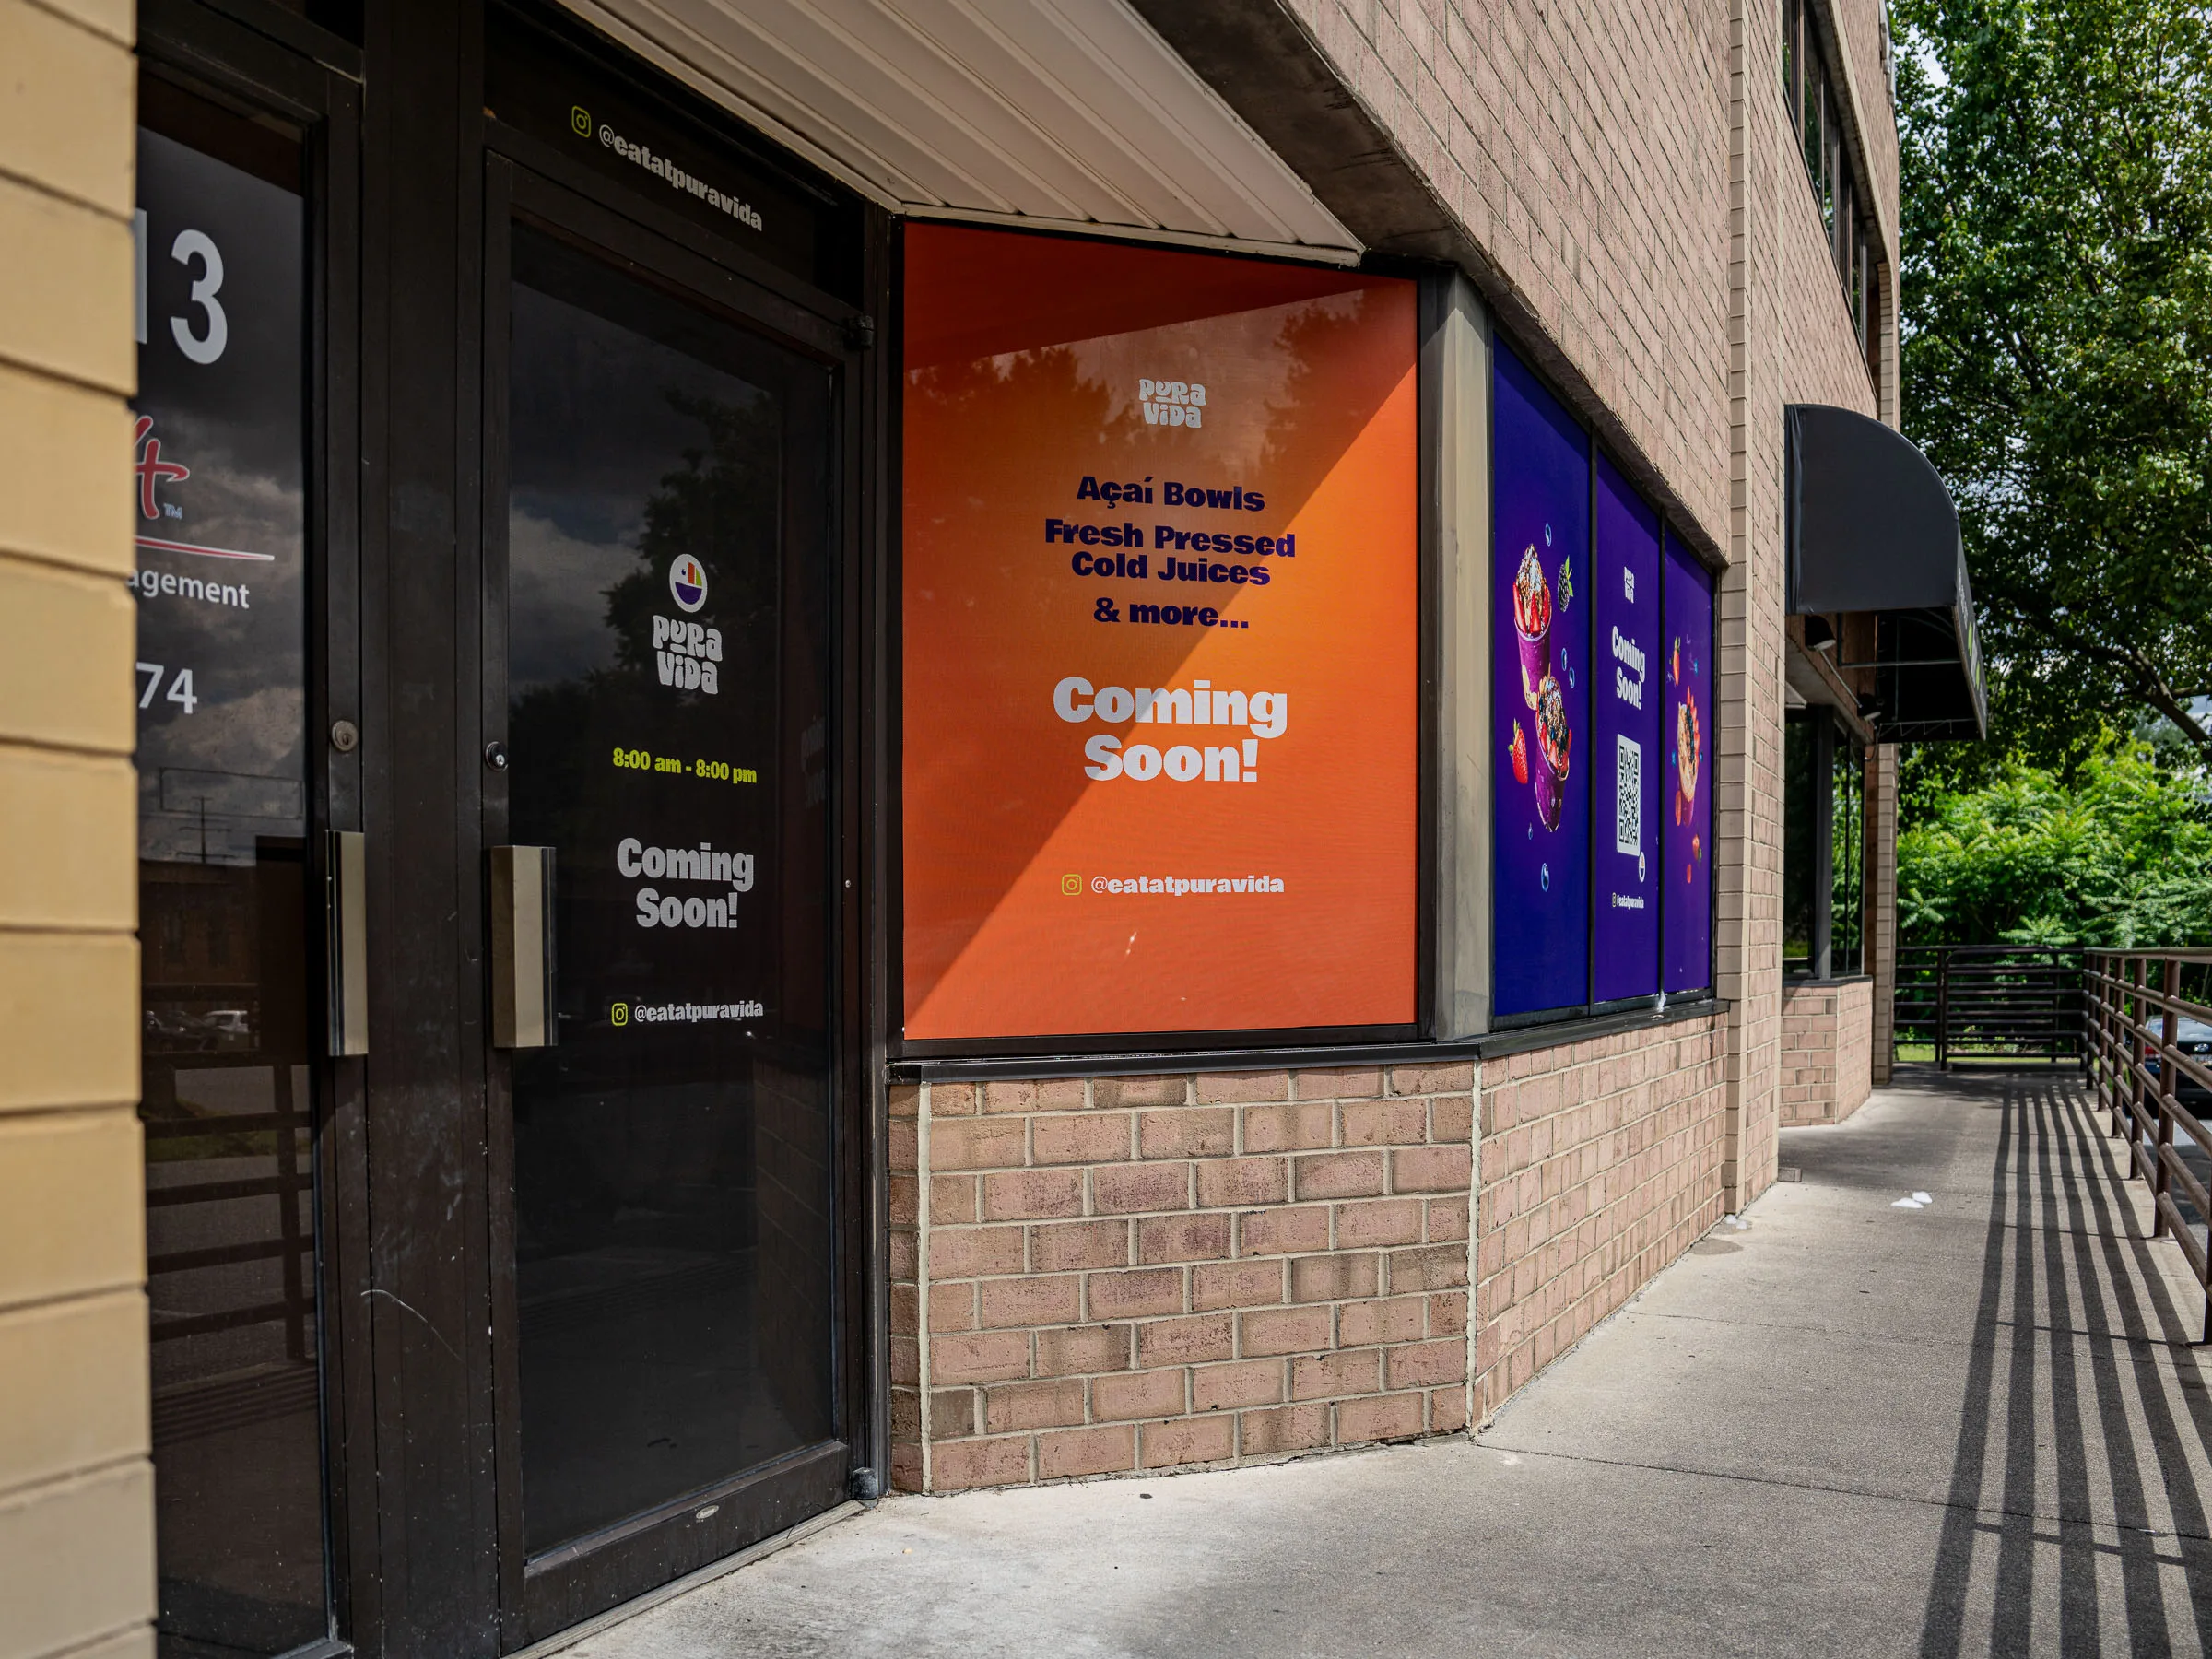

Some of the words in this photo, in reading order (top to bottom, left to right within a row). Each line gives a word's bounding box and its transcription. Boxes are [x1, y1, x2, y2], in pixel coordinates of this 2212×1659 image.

[599, 124, 762, 231] @eatatpuravida
[1077, 476, 1153, 509] Açaí
[1164, 482, 1265, 512] Bowls
[1045, 518, 1144, 547] Fresh
[1155, 525, 1296, 558] Pressed
[1072, 551, 1147, 579] Cold
[1158, 557, 1271, 585] Juices
[1094, 597, 1121, 623] &
[1612, 626, 1645, 683] Coming
[1053, 677, 1287, 739] Coming
[1617, 666, 1641, 710] Soon!
[613, 747, 651, 771] 8:00
[654, 757, 681, 774] am
[696, 759, 729, 781] 8:00
[733, 768, 757, 784] pm
[1084, 735, 1258, 782] Soon!
[617, 838, 754, 892] Coming
[1091, 876, 1285, 896] @eatatpuravida
[636, 888, 738, 929] Soon!
[634, 1000, 763, 1023] @eatatpuravida
